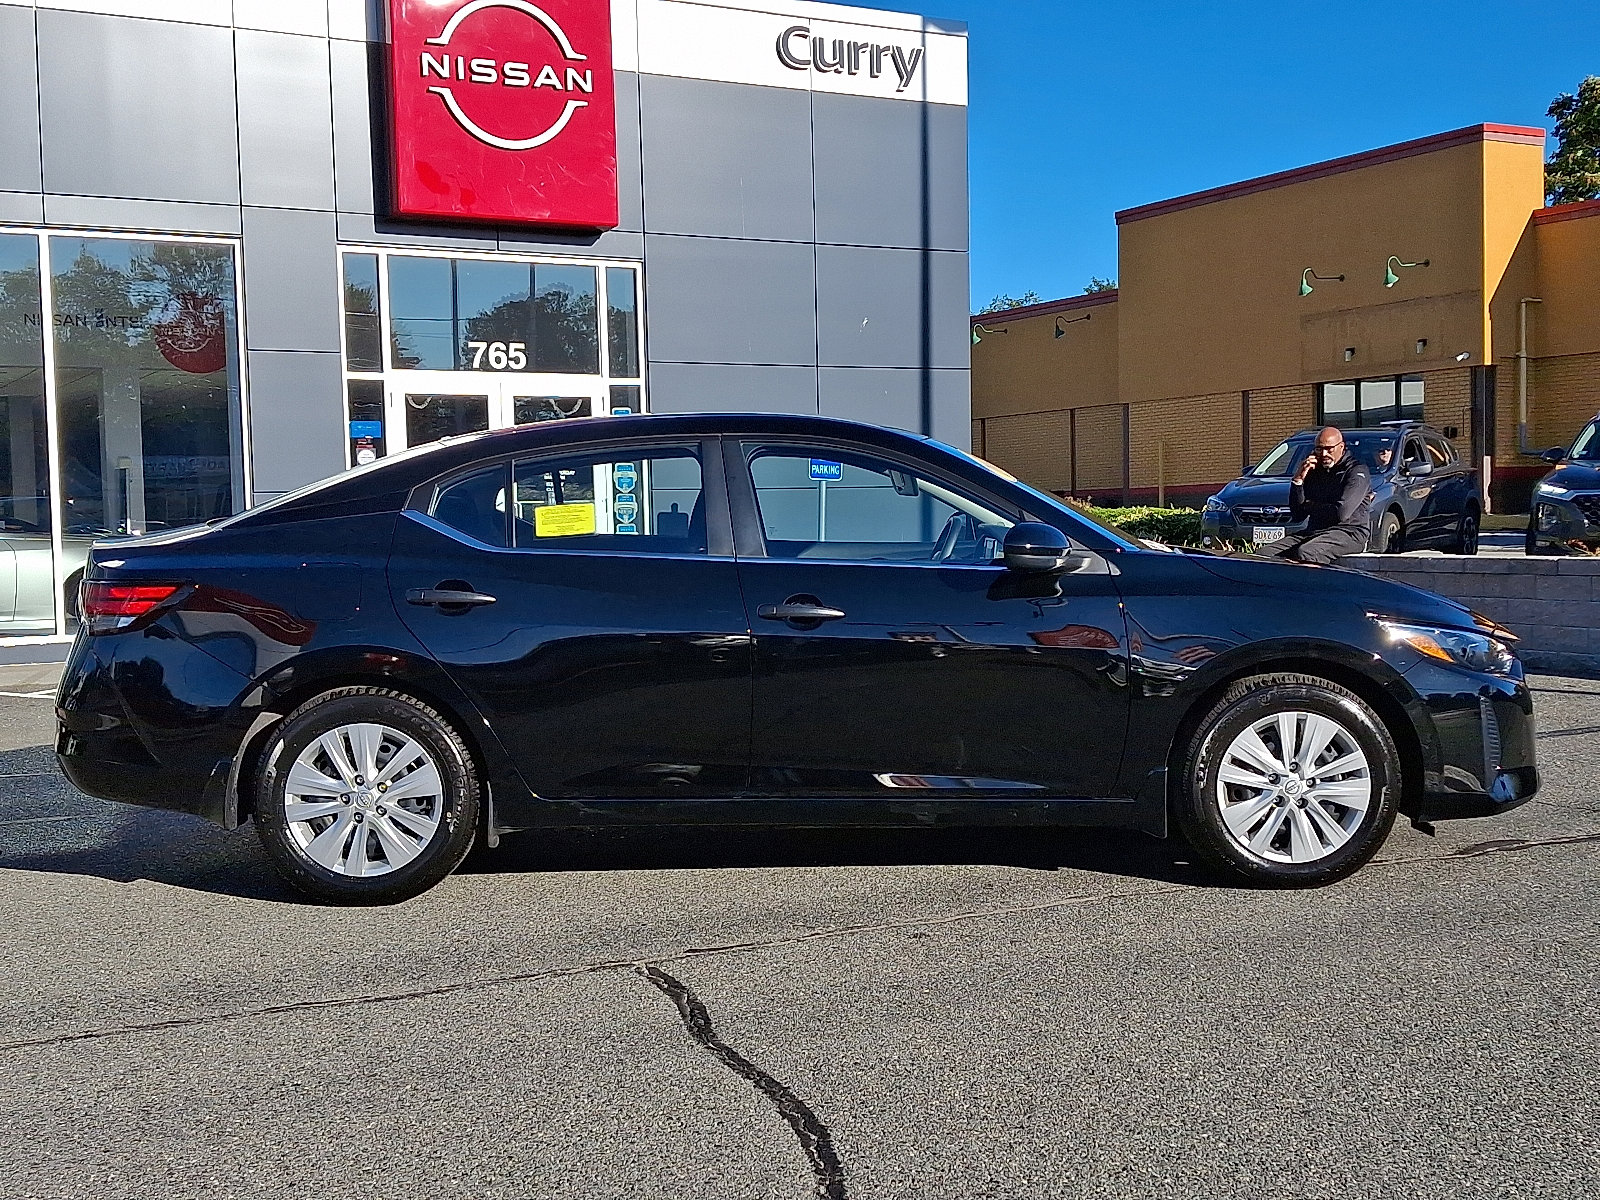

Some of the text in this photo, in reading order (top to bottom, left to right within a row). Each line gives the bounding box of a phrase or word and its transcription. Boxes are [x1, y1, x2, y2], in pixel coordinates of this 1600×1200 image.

[421, 52, 593, 93] NISSAN
[777, 25, 924, 90] Curry
[467, 341, 527, 370] 765
[811, 464, 840, 475] PARKING
